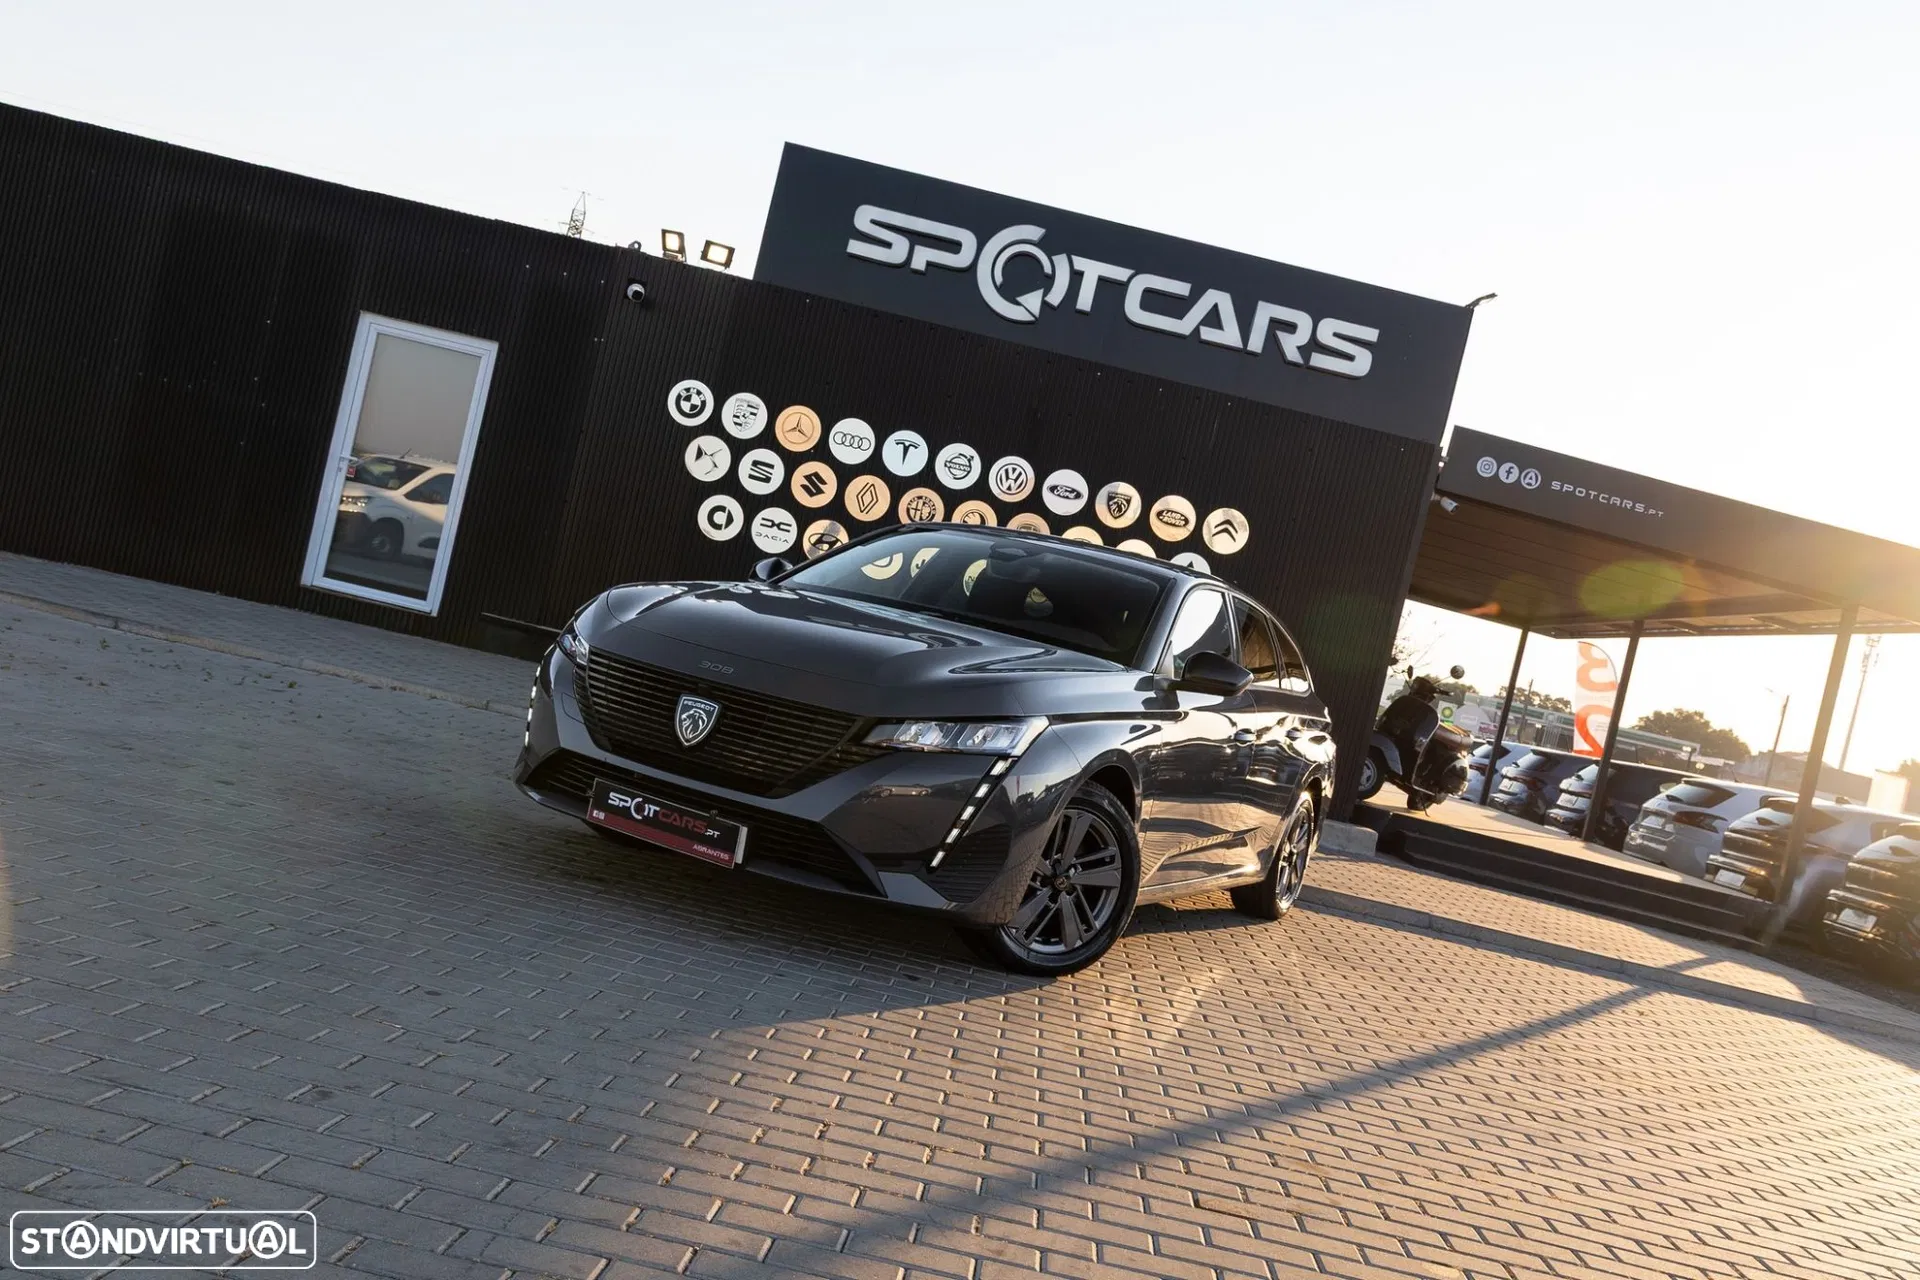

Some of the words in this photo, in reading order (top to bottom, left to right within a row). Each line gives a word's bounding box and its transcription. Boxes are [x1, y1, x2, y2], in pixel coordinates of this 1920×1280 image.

[846, 204, 1380, 378] SPOTCARS
[944, 460, 971, 472] VOLVO
[1053, 485, 1078, 499] Ford
[1551, 480, 1664, 518] SPOTCARS.PT
[1162, 510, 1182, 520] LAND
[1163, 517, 1186, 527] ROVER
[754, 531, 790, 545] DACIA
[698, 660, 734, 674] 308
[683, 700, 715, 711] PEUGEOT
